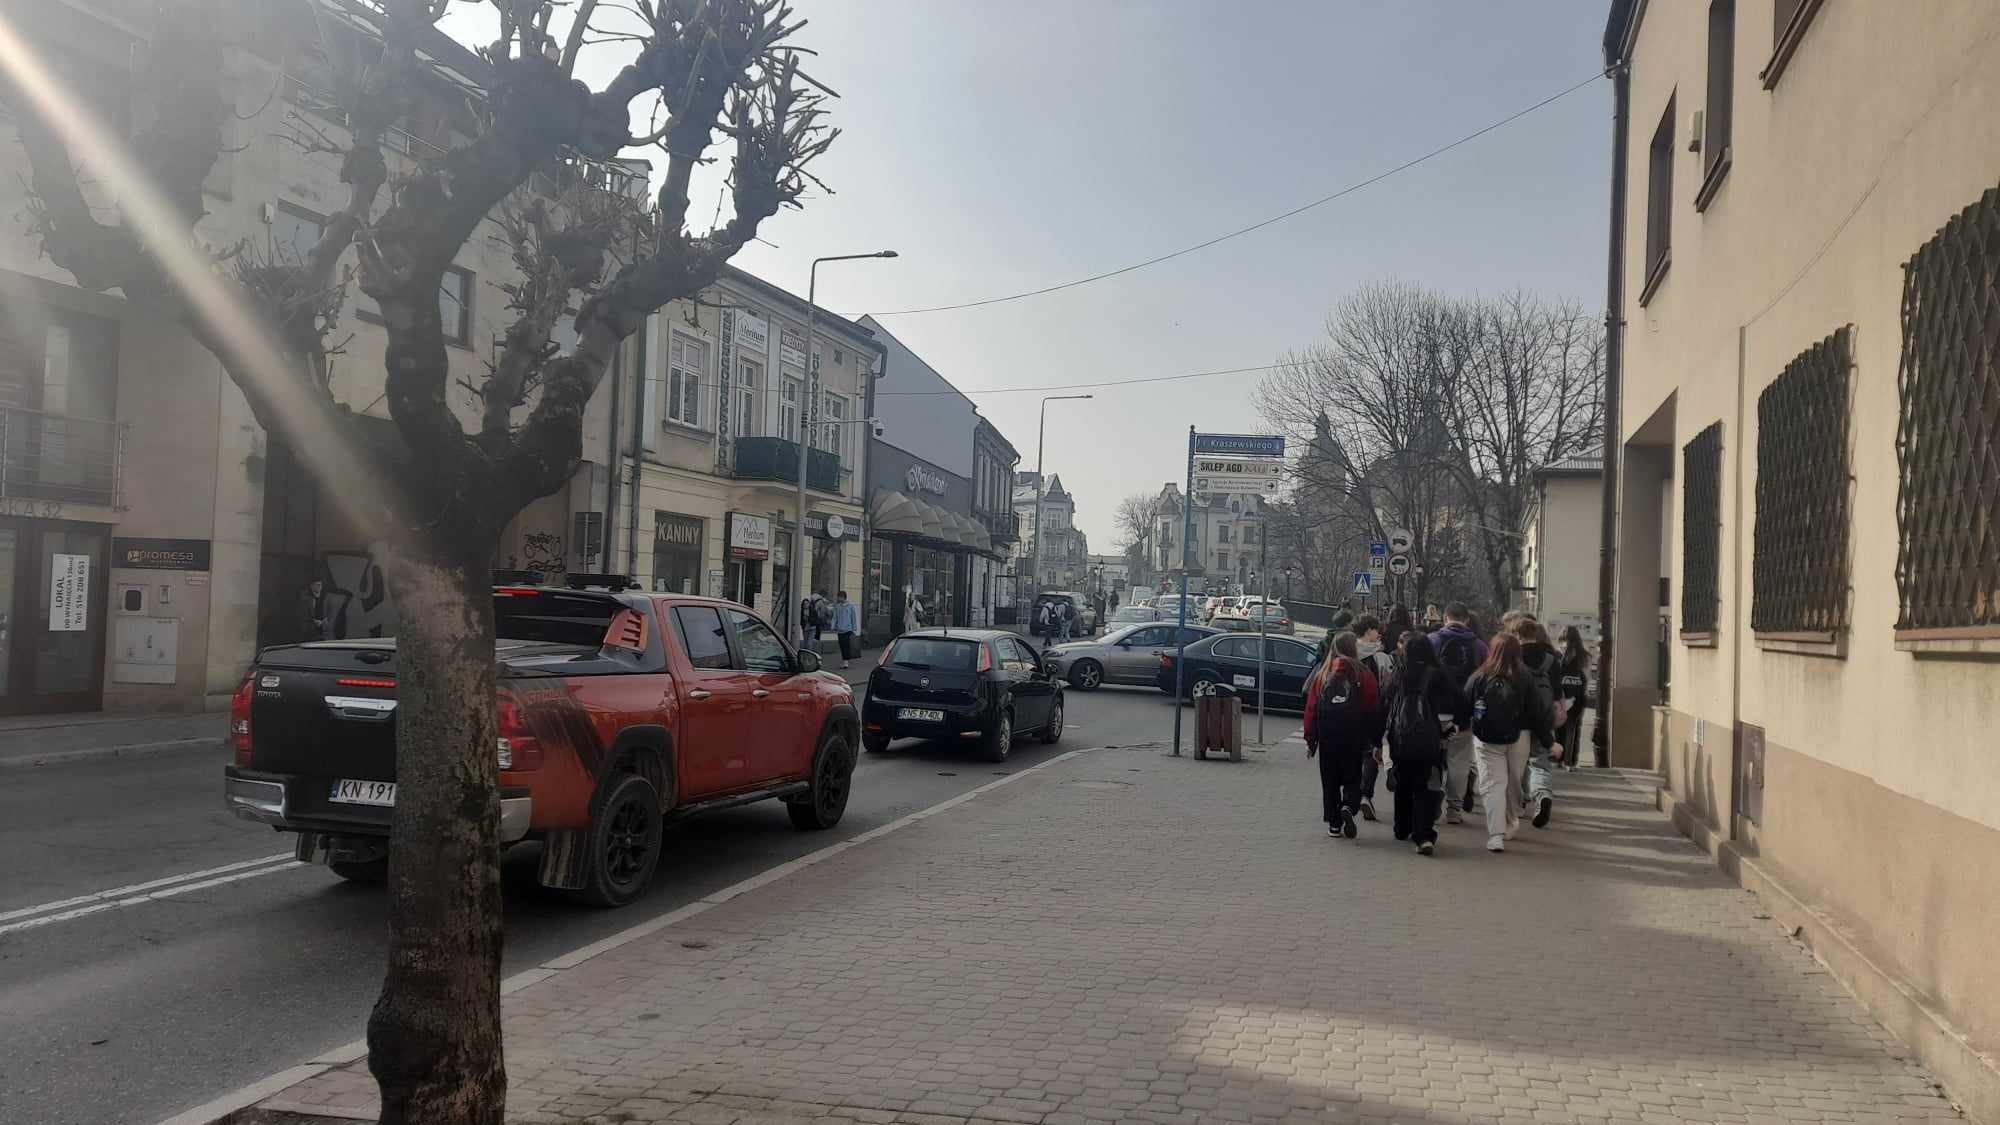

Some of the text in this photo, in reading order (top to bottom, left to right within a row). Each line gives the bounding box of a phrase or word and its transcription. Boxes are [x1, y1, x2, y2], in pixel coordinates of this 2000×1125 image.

[1210, 439, 1273, 450] Kraszewskiego
[1200, 462, 1224, 472] SKLEP
[55, 576, 65, 608] LOKAL
[256, 690, 280, 698] TOYOTA
[340, 780, 394, 801] KN 191
